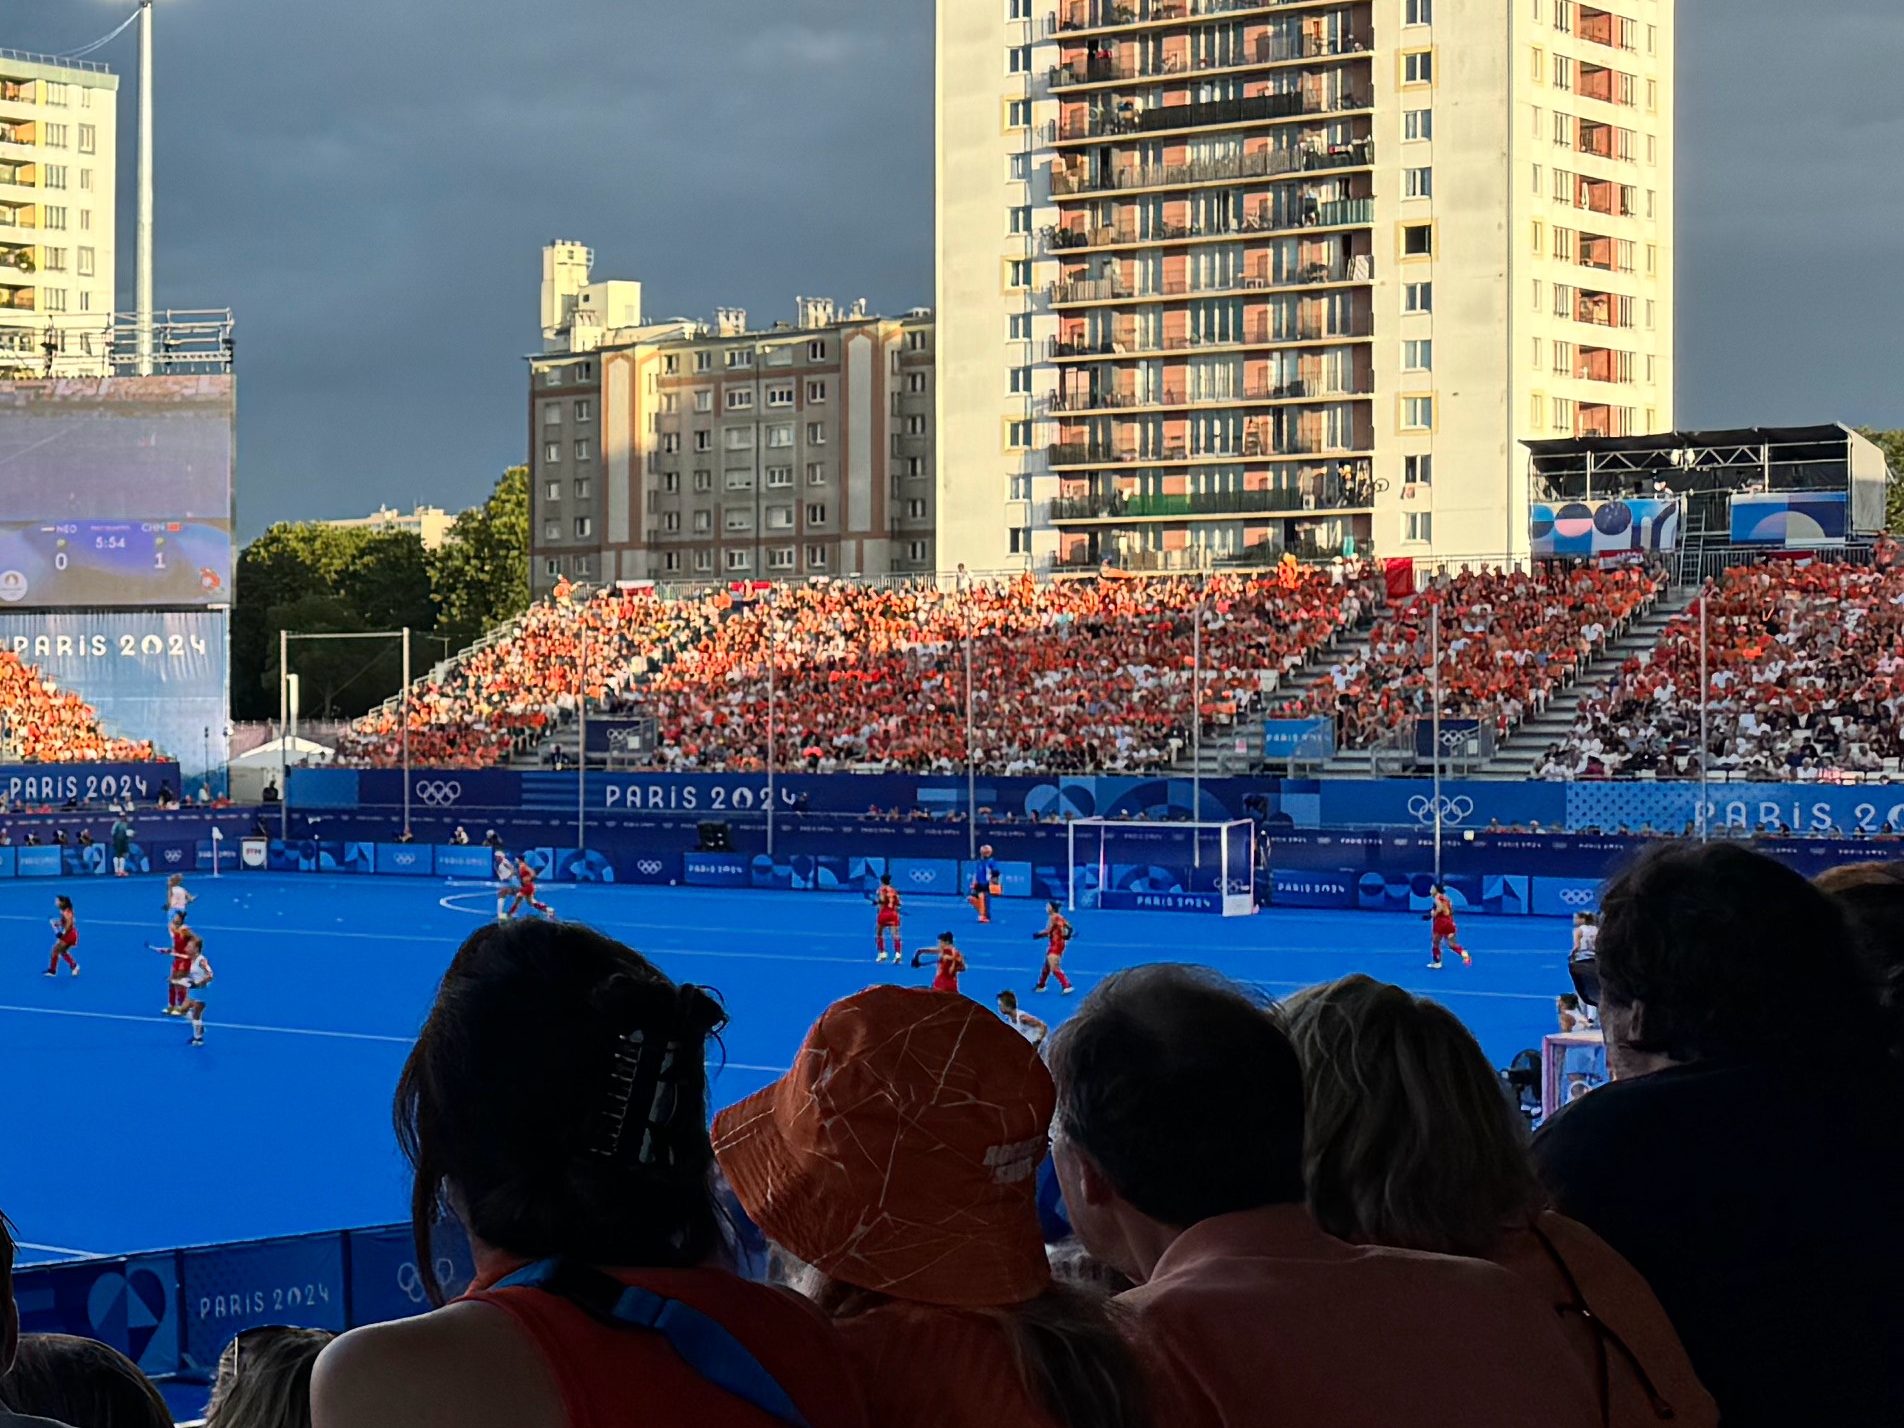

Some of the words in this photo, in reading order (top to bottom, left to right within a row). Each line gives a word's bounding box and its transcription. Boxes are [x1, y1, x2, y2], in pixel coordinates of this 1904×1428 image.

[95, 536, 126, 549] 5:54
[55, 552, 68, 571] 0
[154, 552, 166, 569] 1
[14, 634, 107, 657] PARIS
[120, 634, 206, 656] 2024
[10, 775, 78, 800] PARIS
[86, 774, 147, 798] 2024
[605, 784, 697, 809] PARIS
[1694, 800, 1833, 831] PARIS
[1136, 895, 1173, 908] PARIS
[1177, 896, 1211, 909] 2024
[200, 1291, 265, 1320] PARIS
[273, 1283, 330, 1311] 2024
